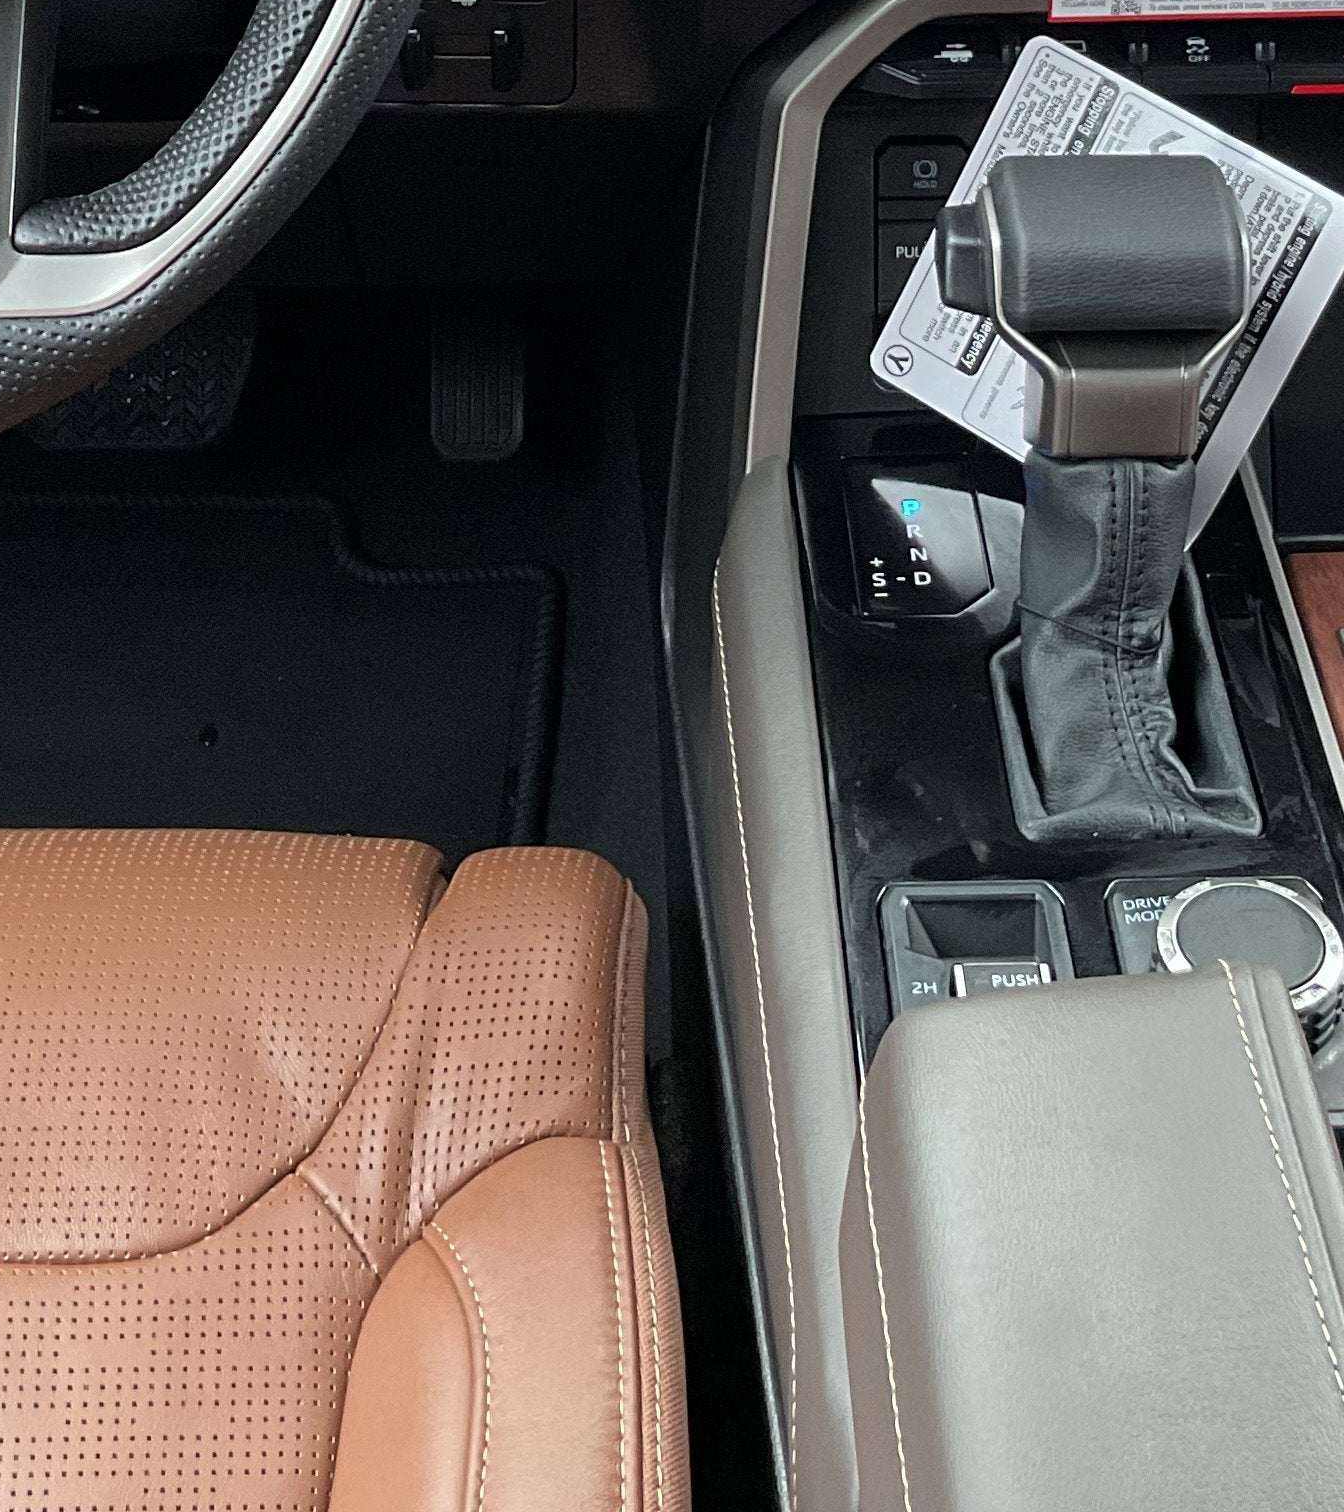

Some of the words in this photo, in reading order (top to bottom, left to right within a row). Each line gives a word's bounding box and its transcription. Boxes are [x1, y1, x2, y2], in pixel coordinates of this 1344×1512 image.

[1031, 58, 1048, 79] See
[1040, 63, 1057, 85] than
[1021, 81, 1037, 99] the
[1047, 80, 1058, 91] or
[1033, 92, 1052, 118] more
[1049, 76, 1083, 127] emergency
[1070, 94, 1085, 112] you
[1077, 84, 1115, 137] Stopping
[1000, 99, 1027, 139] Owner's
[1056, 115, 1075, 140] want
[1050, 142, 1061, 154] to
[896, 246, 921, 258] PUL
[1265, 232, 1282, 254] shift
[1253, 253, 1271, 276] lever
[931, 311, 953, 341] switch
[1246, 299, 1274, 334] system
[920, 317, 939, 342] more
[948, 339, 961, 354] an
[1233, 341, 1252, 360] the
[1210, 358, 1243, 403] electronic
[1198, 400, 1220, 421] key
[901, 499, 921, 516] P
[906, 524, 923, 538] R
[910, 547, 928, 562] N
[872, 572, 887, 587] S
[913, 571, 932, 586] D
[1122, 895, 1170, 911] DRIVE
[912, 982, 938, 995] 2H
[992, 973, 1040, 988] PUSH
